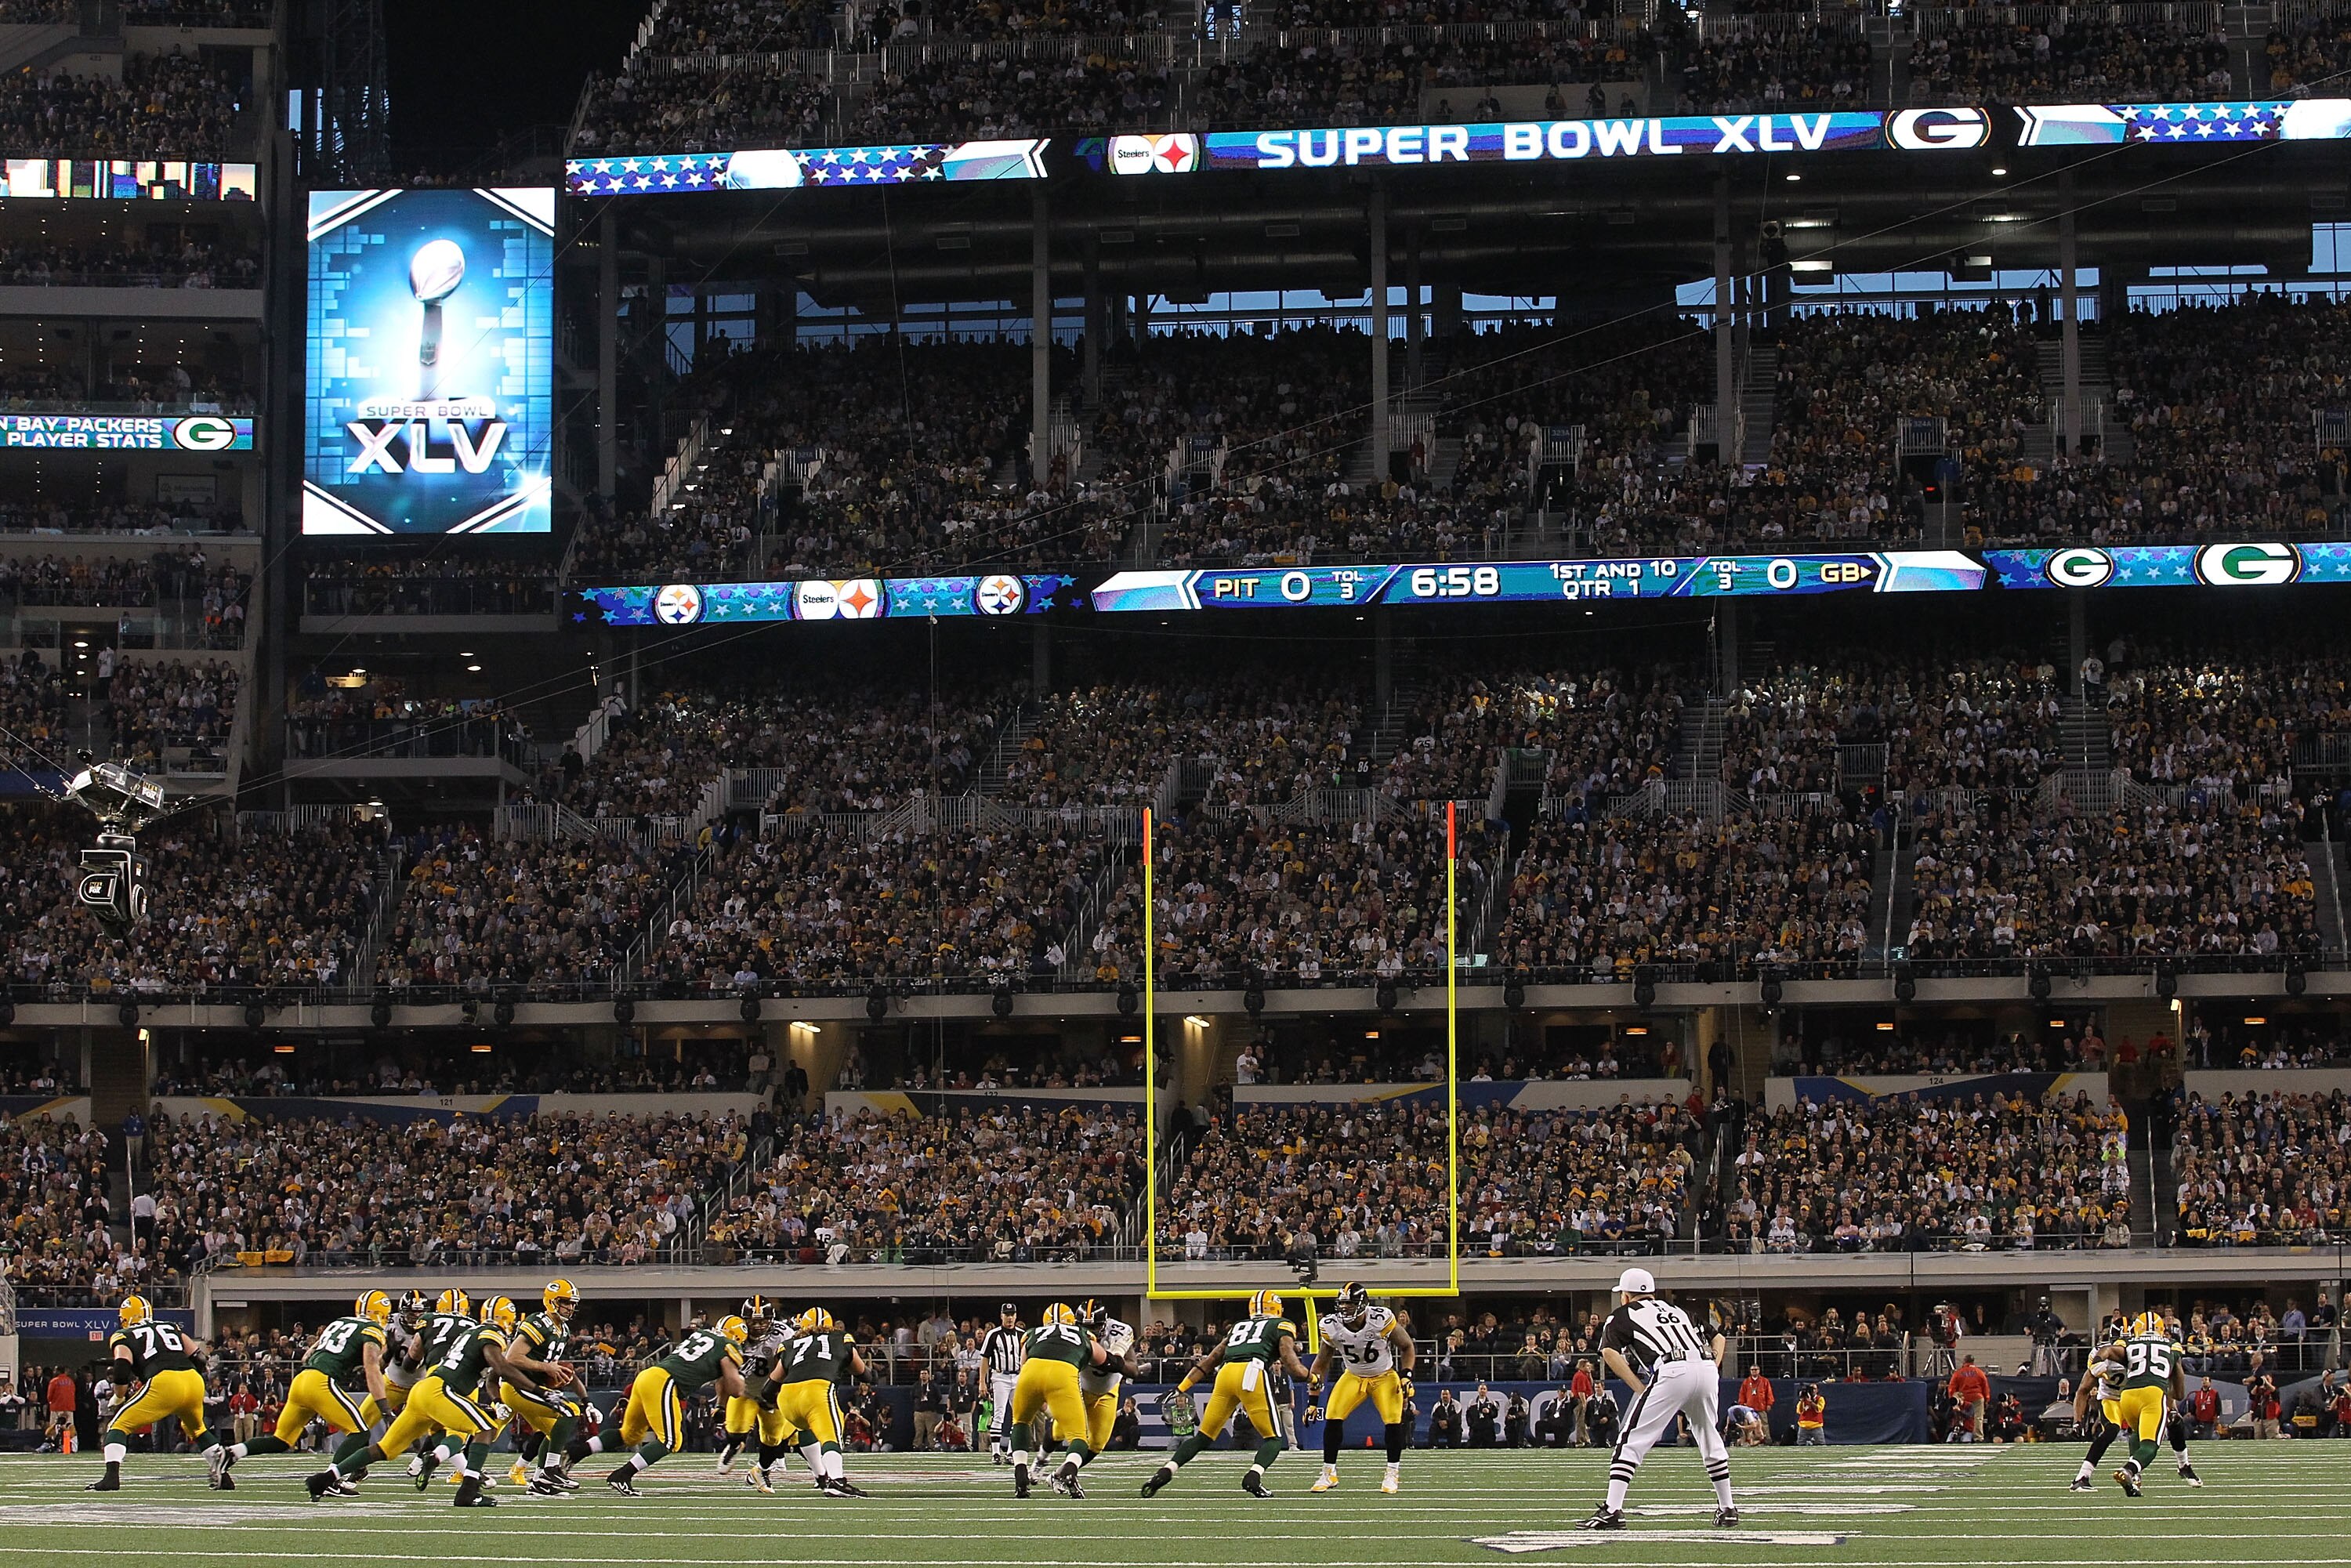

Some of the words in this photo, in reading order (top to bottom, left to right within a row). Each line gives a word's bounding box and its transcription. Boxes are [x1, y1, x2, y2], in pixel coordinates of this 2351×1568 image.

[1256, 126, 1469, 168] SUPER
[1504, 118, 1683, 160] BOWL
[1711, 114, 1832, 153] XLV
[1118, 149, 1150, 159] Steelers
[367, 406, 426, 417] SUPER
[437, 406, 488, 417] BOWL
[16, 417, 60, 431] BAY
[67, 418, 163, 433] PACKERS
[7, 432, 88, 447] PLAYER
[96, 433, 163, 448] STATS
[346, 422, 508, 473] XLV
[1549, 563, 1587, 579] 1ST
[1594, 563, 1642, 578] AND
[1650, 560, 1677, 577] 10
[1709, 560, 1742, 573] TOL
[1767, 559, 1797, 588] 0
[1820, 563, 1860, 582] GB
[1331, 570, 1364, 582] TOL
[1411, 567, 1500, 597] 6:58
[1717, 573, 1732, 589] 3
[1214, 578, 1259, 598] PIT
[1281, 571, 1310, 601] 0
[1340, 582, 1354, 599] 3
[1563, 580, 1612, 600] QTR
[1628, 579, 1639, 596] 1
[802, 594, 834, 604] Steelers
[1357, 762, 1369, 773] 86
[141, 788, 158, 801] FOX
[89, 885, 102, 894] FOX
[820, 1234, 831, 1244] 12
[84, 1320, 110, 1329] XLV
[1656, 1313, 1680, 1324] 66
[315, 1320, 358, 1354] 83
[1034, 1324, 1082, 1346] 75
[1110, 1323, 1126, 1337] 93
[1227, 1320, 1269, 1347] 81
[132, 1324, 184, 1360] 76
[792, 1334, 832, 1366] 71
[1342, 1340, 1380, 1363] 56
[2125, 1343, 2171, 1378] 85
